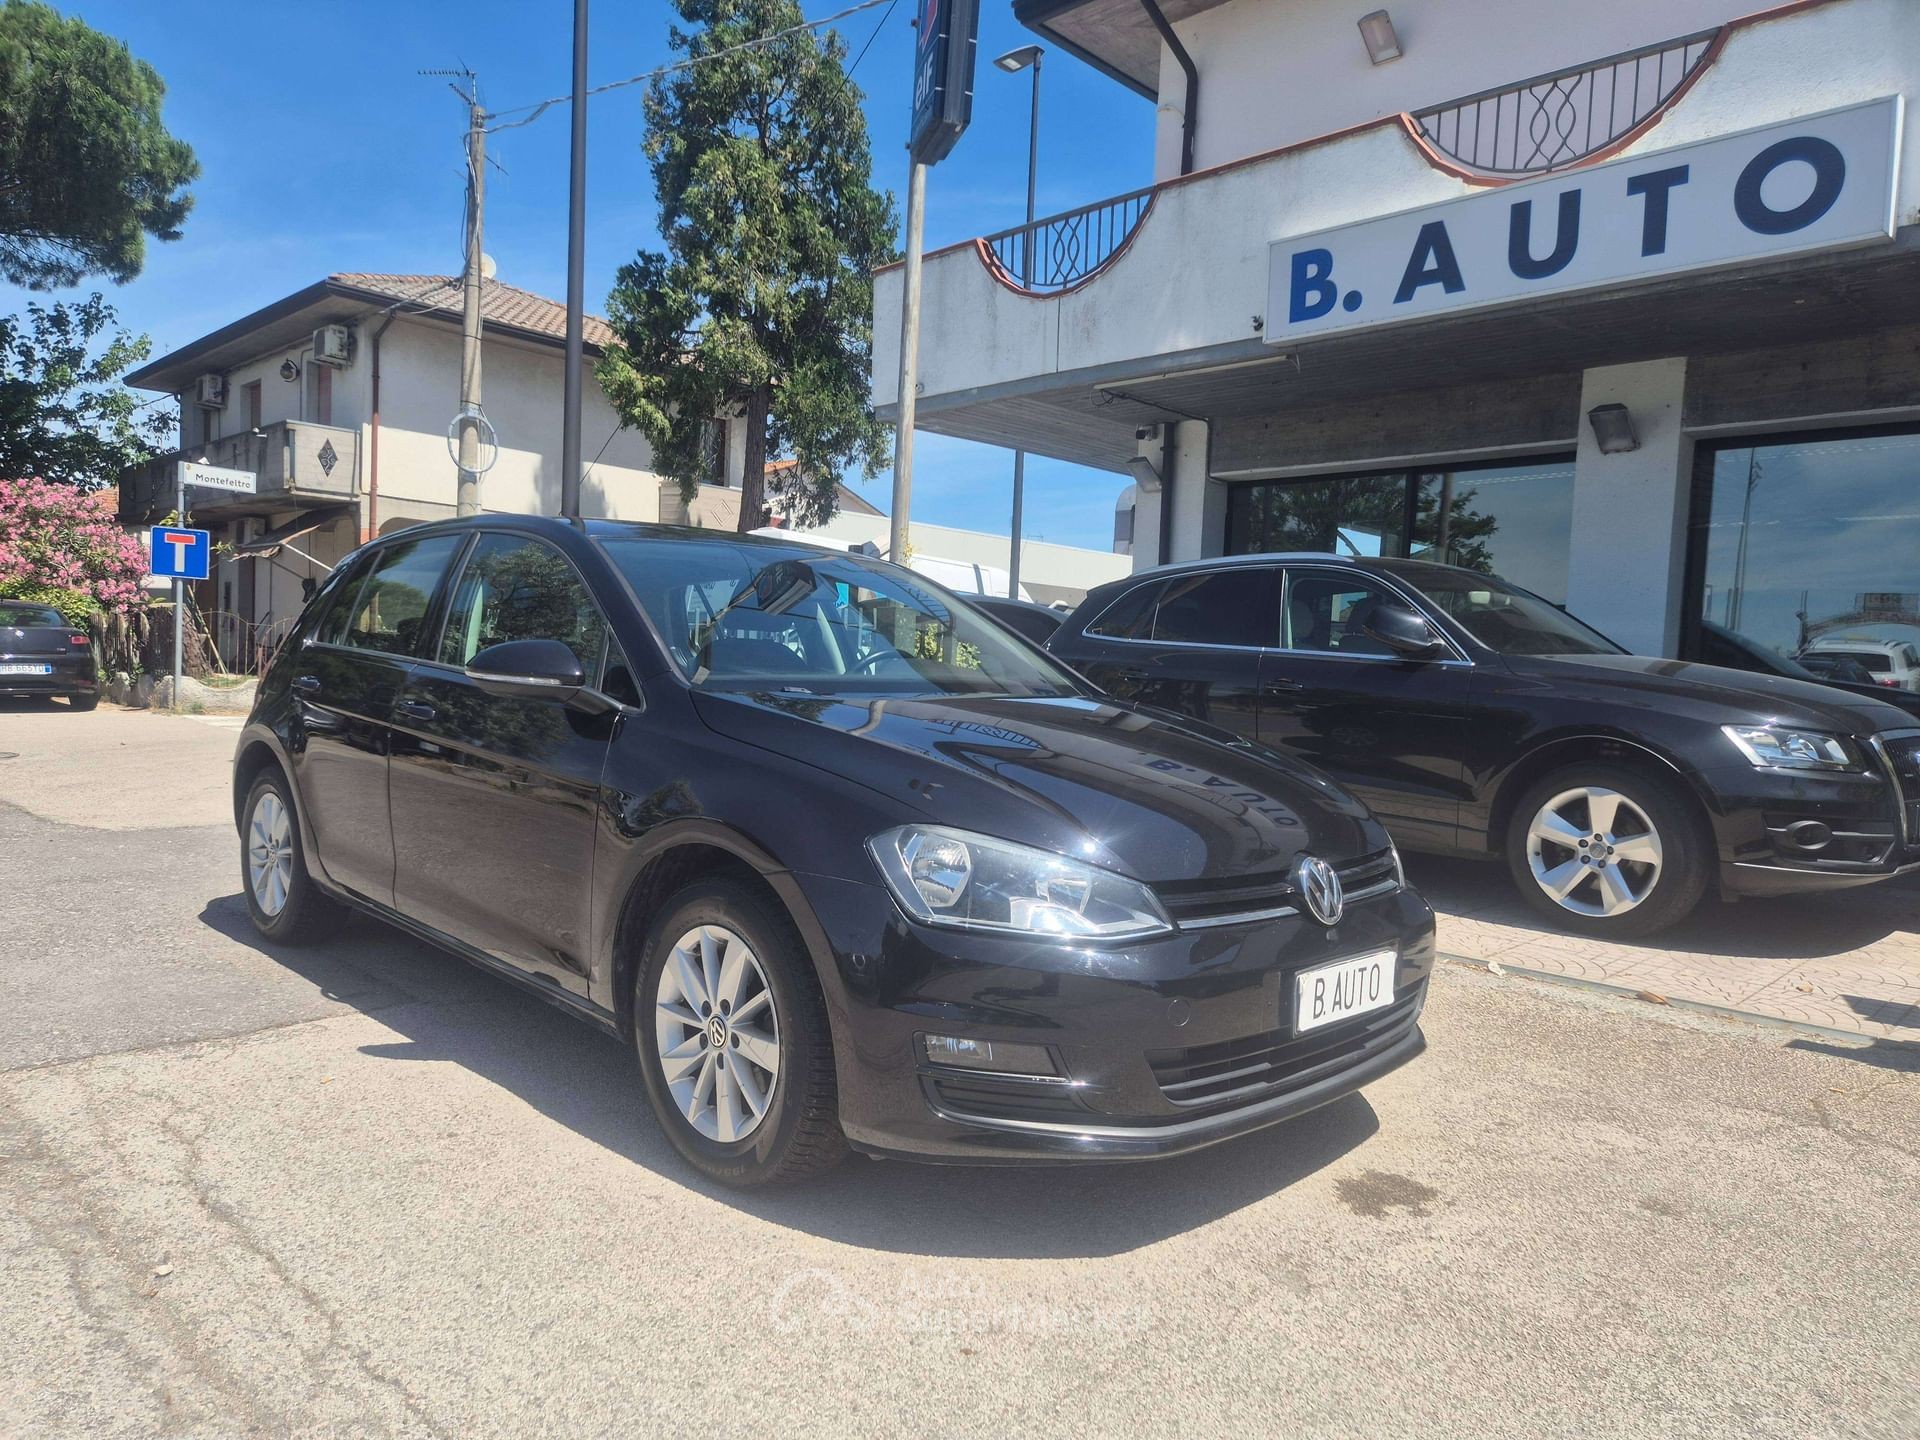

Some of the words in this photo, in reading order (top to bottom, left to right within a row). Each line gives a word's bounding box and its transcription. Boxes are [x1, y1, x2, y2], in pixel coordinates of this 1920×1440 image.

[915, 51, 934, 111] elf
[1289, 248, 1363, 323] B.
[1393, 136, 1846, 304] AUTO
[195, 473, 251, 489] Montefeltro
[1313, 978, 1326, 1019] B.
[1332, 963, 1380, 1013] AUTO
